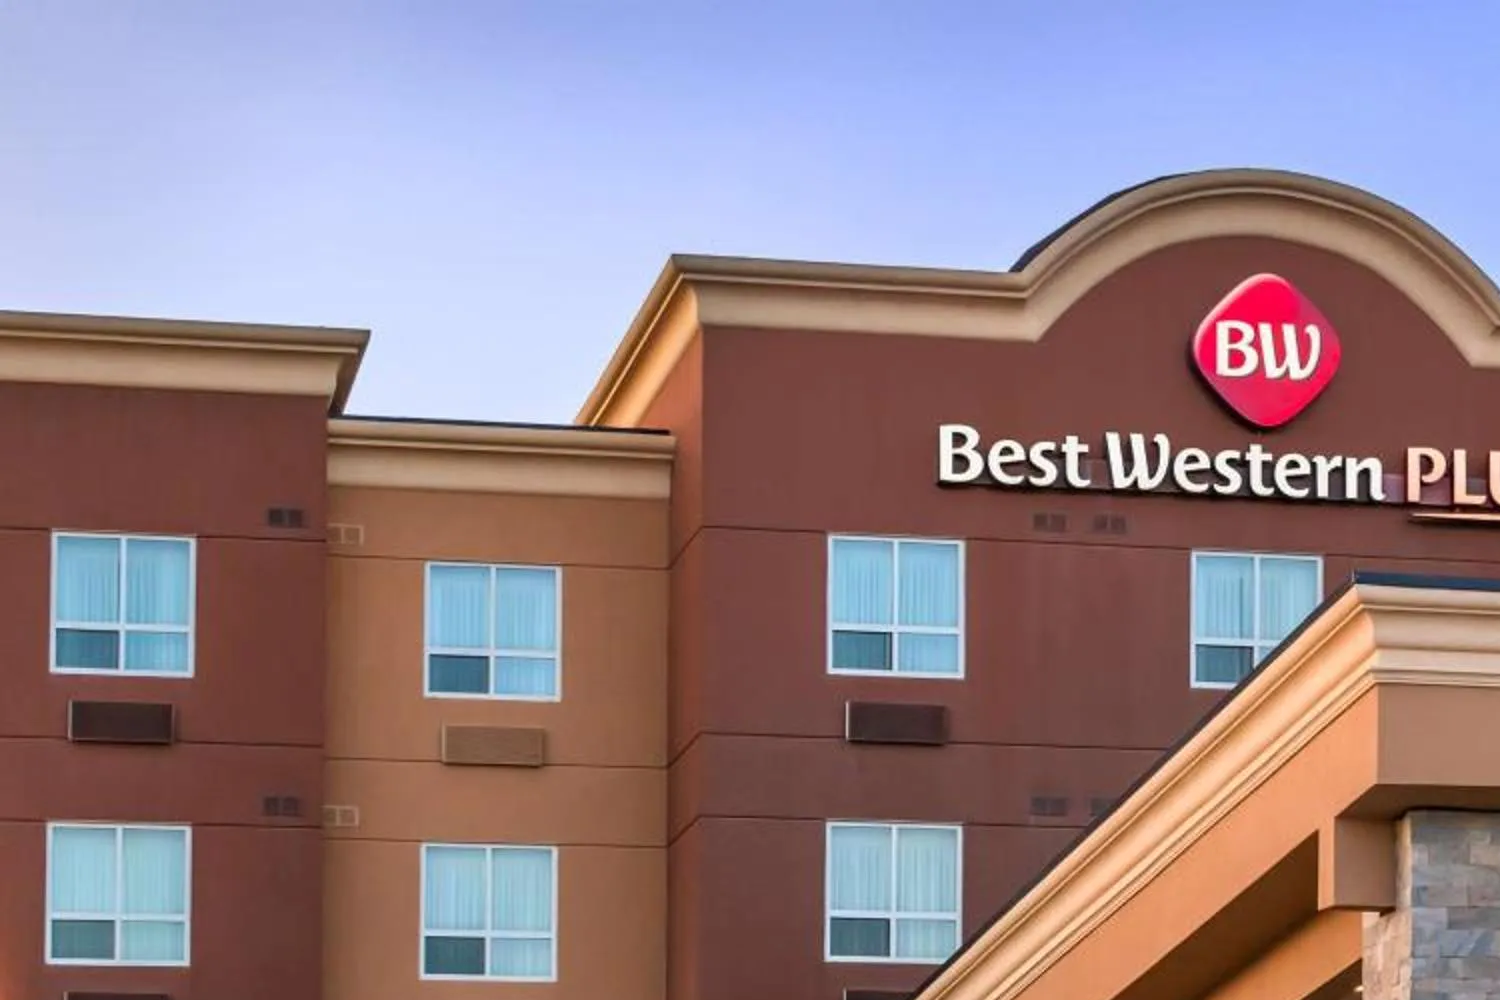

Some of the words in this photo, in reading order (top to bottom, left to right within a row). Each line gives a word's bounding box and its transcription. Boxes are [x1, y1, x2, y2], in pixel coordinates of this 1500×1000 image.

[1215, 319, 1321, 381] BW
[938, 423, 1092, 488] Best
[1105, 431, 1387, 501] Western
